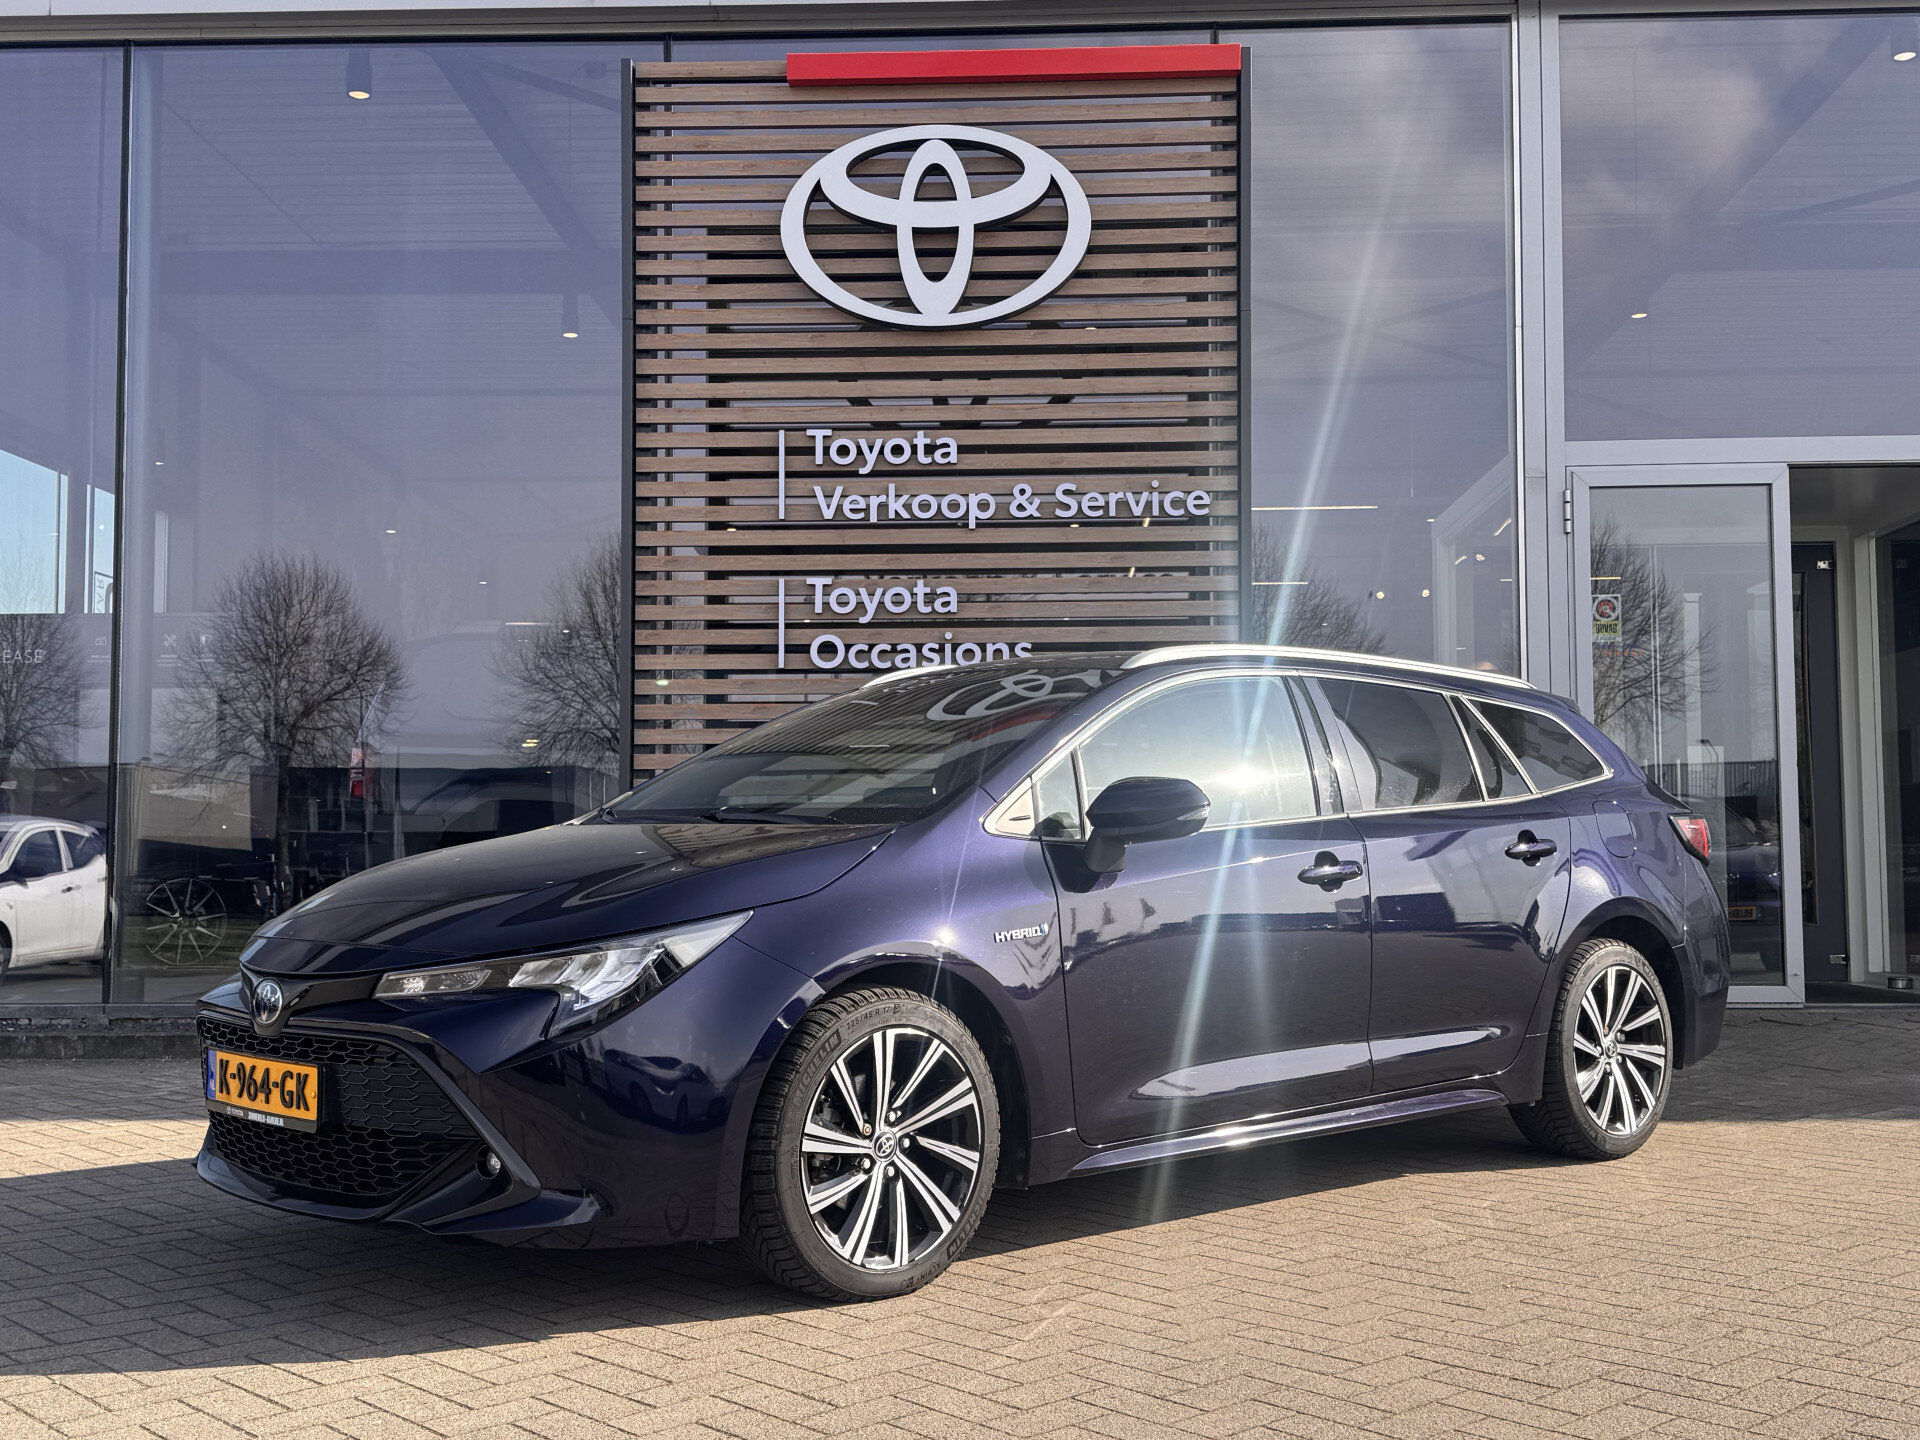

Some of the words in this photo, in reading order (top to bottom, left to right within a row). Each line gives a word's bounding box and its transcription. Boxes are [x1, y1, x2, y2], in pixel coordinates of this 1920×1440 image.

[806, 429, 958, 474] Toyota
[813, 483, 997, 529] Verkoop
[1009, 483, 1042, 518] &
[1055, 479, 1212, 517] Service
[806, 578, 958, 623] Toyota
[0, 649, 44, 664] EASE
[809, 632, 1033, 669] Occasions
[994, 925, 1041, 943] HYBRID
[218, 1058, 309, 1111] K-964-GK
[792, 1032, 840, 1106] MICHELIN
